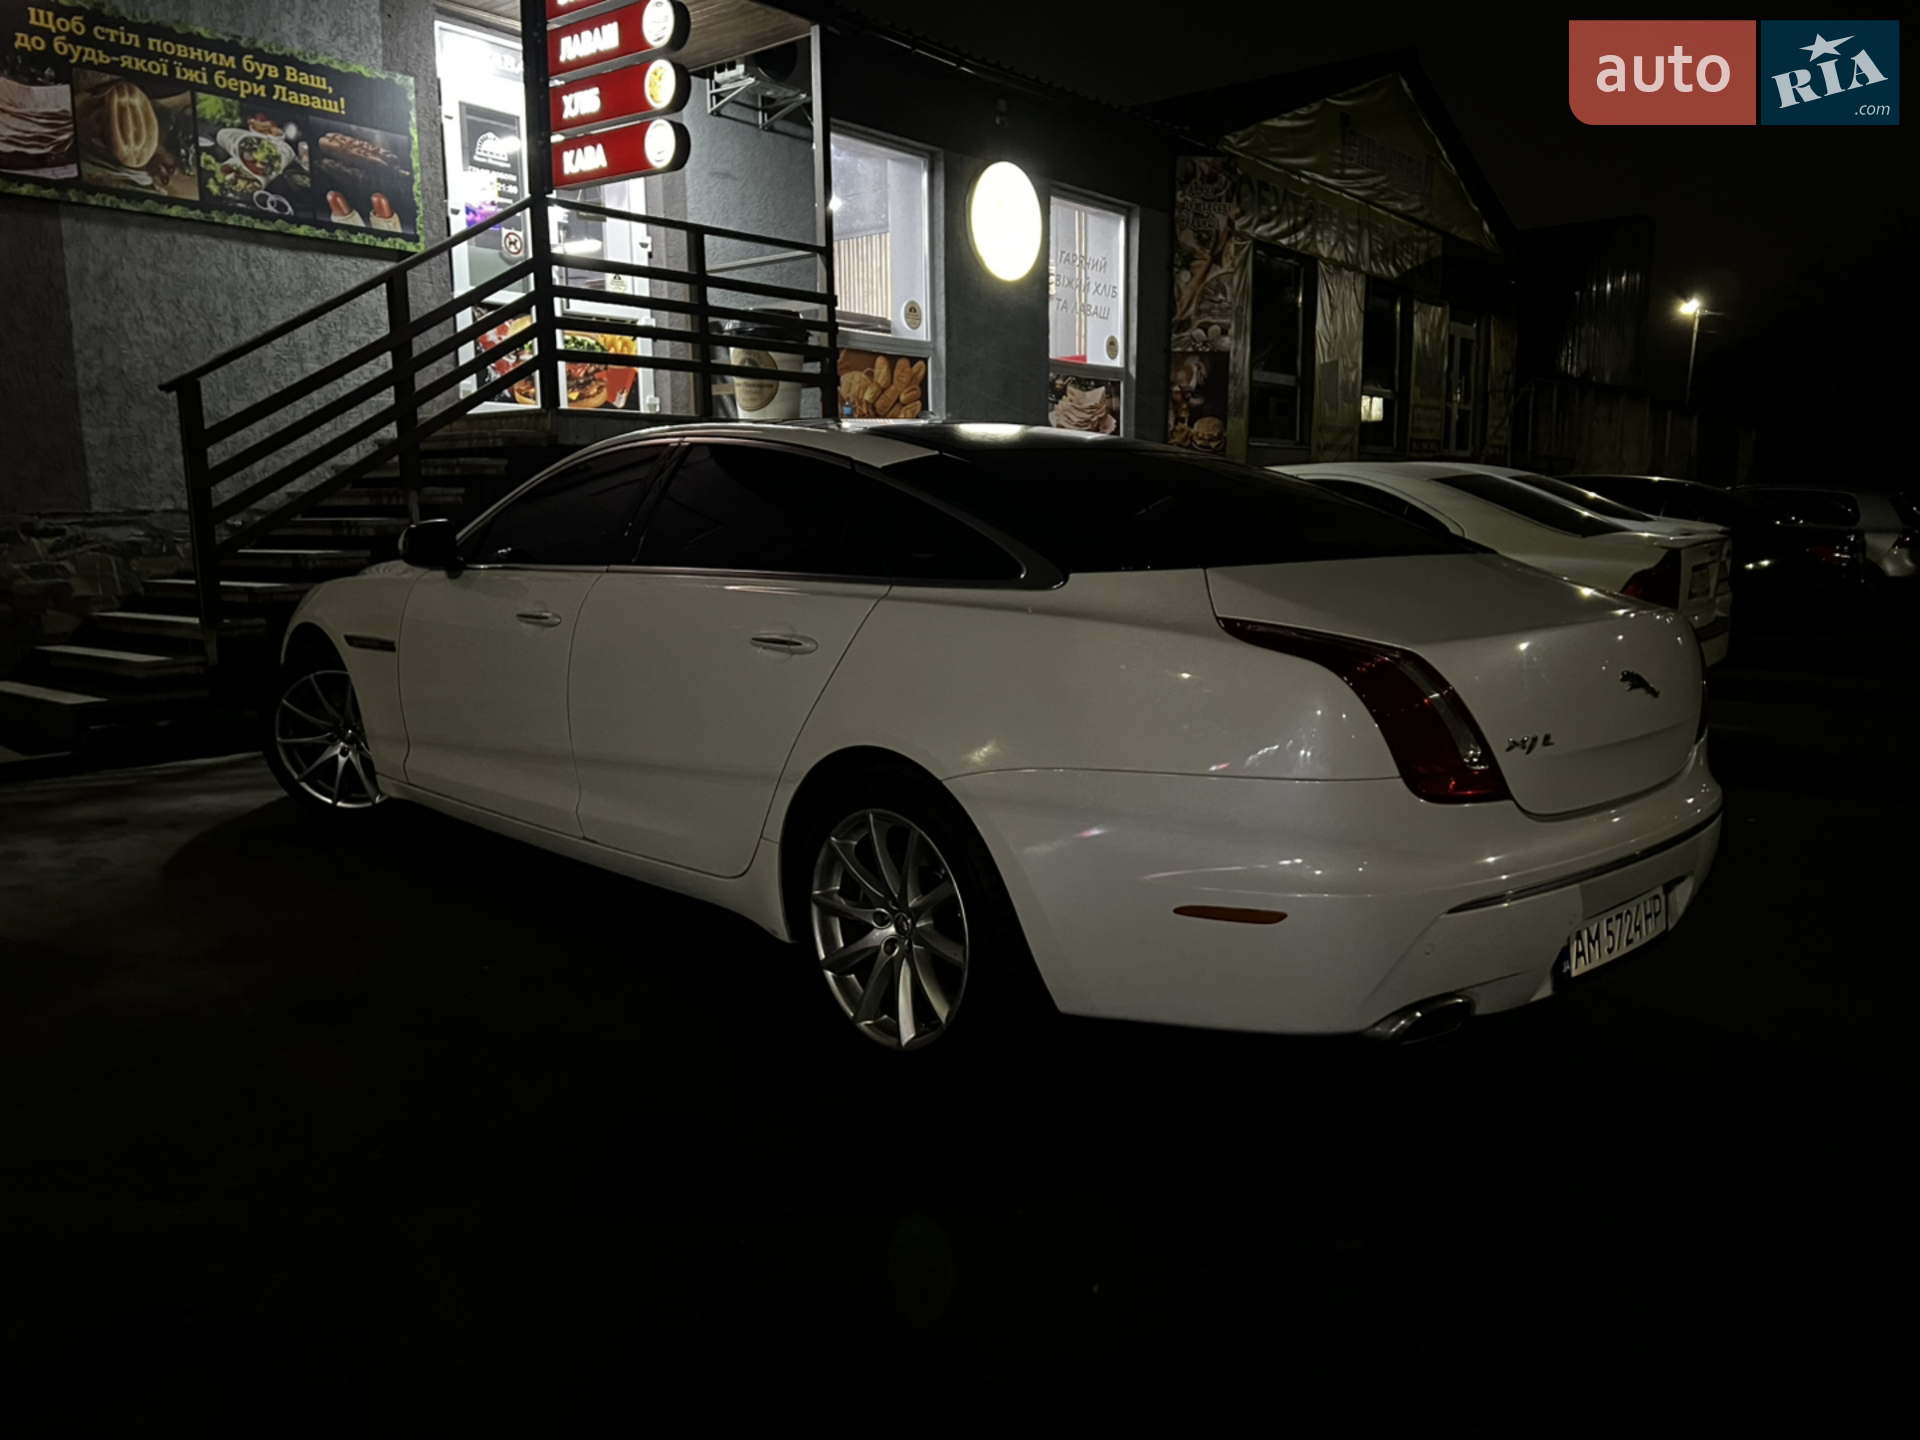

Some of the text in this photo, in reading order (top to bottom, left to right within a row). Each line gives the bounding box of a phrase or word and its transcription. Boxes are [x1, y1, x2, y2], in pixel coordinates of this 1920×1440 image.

[28, 7, 333, 94] Щоб стіл повним був Ваш,
[559, 21, 620, 63] ЛАВАШ
[14, 32, 346, 115] до будь-якої їжі бери Лаваш!
[563, 143, 608, 175] КАВА
[1055, 297, 1069, 313] ТА
[1092, 281, 1118, 299] ХЛІБ
